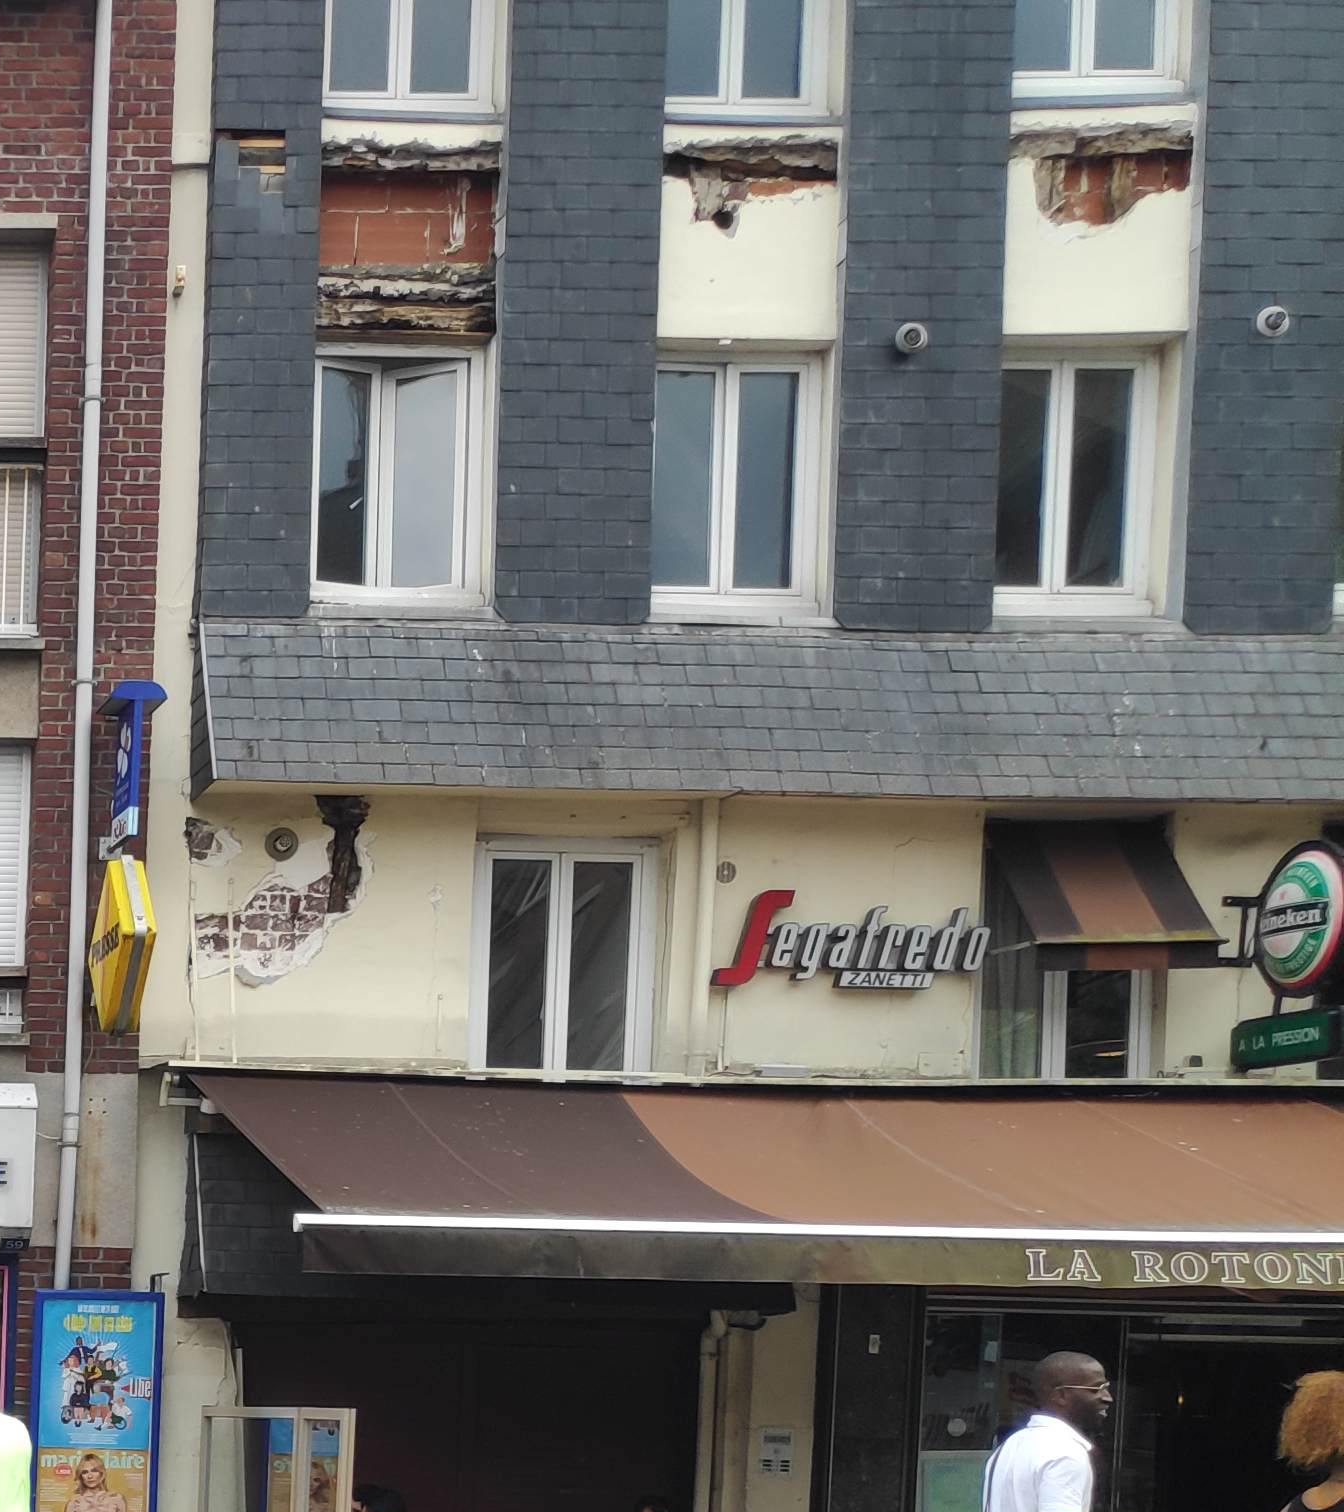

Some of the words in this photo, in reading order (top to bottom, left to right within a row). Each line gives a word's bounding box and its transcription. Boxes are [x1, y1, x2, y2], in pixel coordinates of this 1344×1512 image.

[1260, 908, 1322, 930] ineken
[710, 889, 991, 987] Segafredo
[847, 972, 927, 986] ZANETTI
[1238, 1038, 1246, 1051] A
[1252, 1035, 1265, 1050] LA
[1272, 1026, 1320, 1047] PRESSION
[6, 1240, 24, 1249] 59
[1025, 1248, 1102, 1282] LA
[1130, 1250, 1344, 1285] ROTON
[40, 1450, 81, 1468] mari
